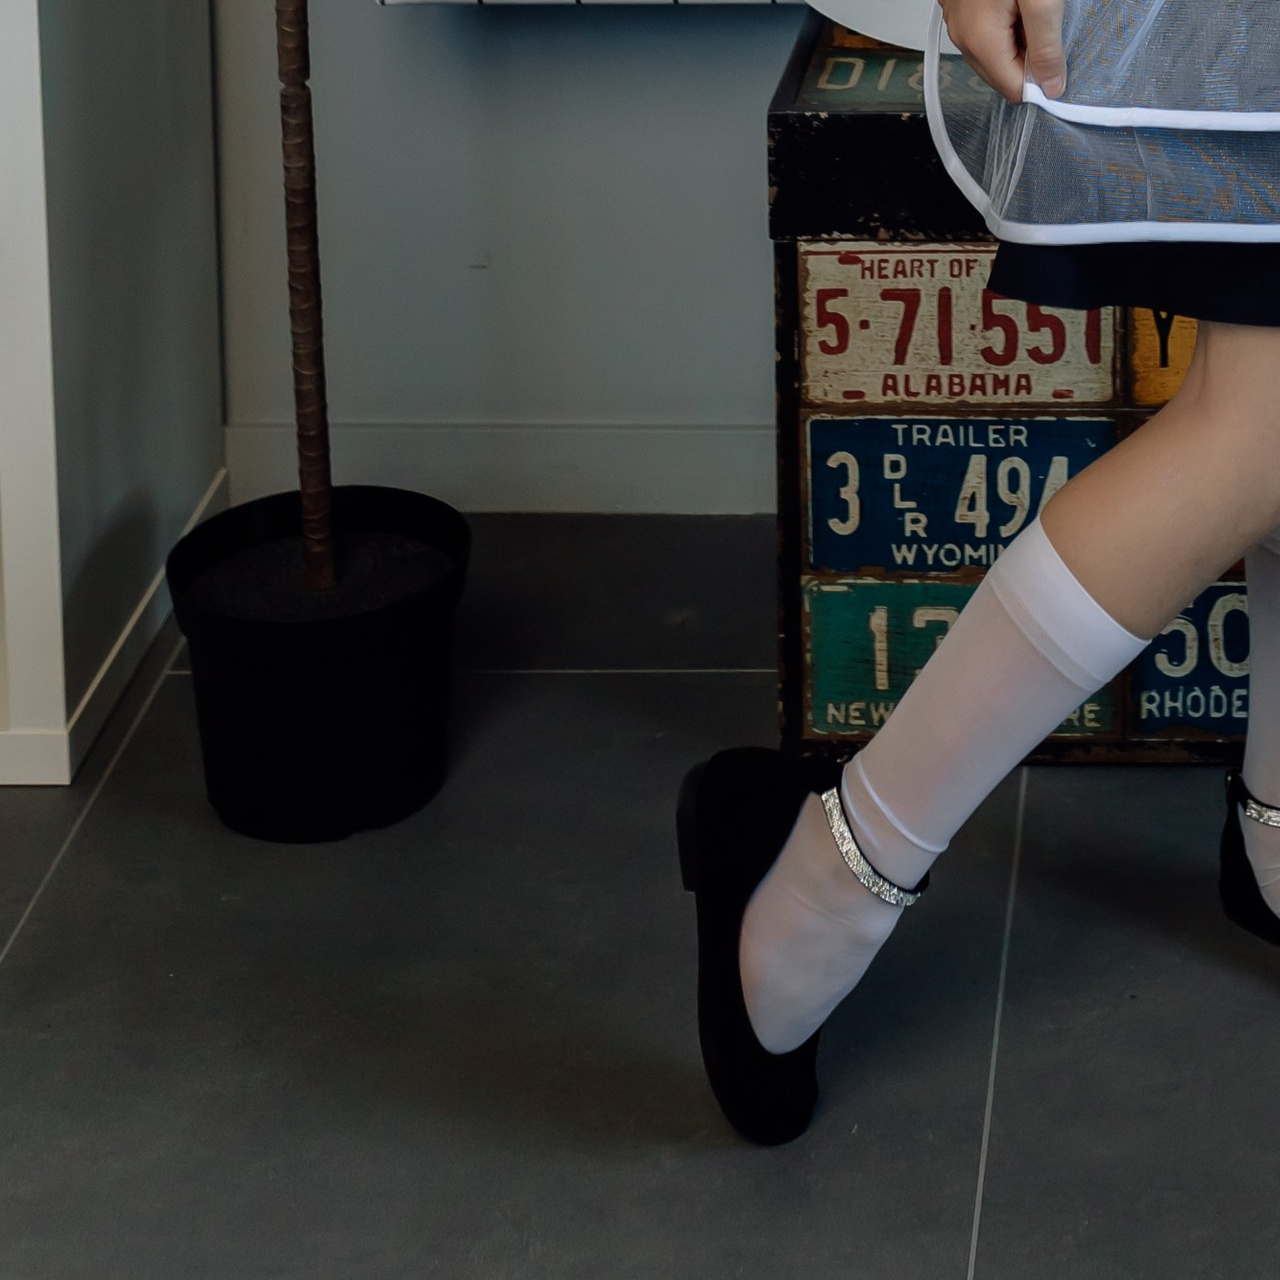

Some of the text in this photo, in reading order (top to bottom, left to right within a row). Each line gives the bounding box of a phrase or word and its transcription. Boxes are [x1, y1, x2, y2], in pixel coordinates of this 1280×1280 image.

[861, 258, 939, 279] HEART
[950, 258, 978, 279] OF
[882, 373, 1032, 398] ALABAMA
[891, 424, 1028, 448] TRAILER
[826, 451, 860, 536] 3
[827, 702, 897, 726] NEW
[1141, 686, 1248, 719] RHODE
